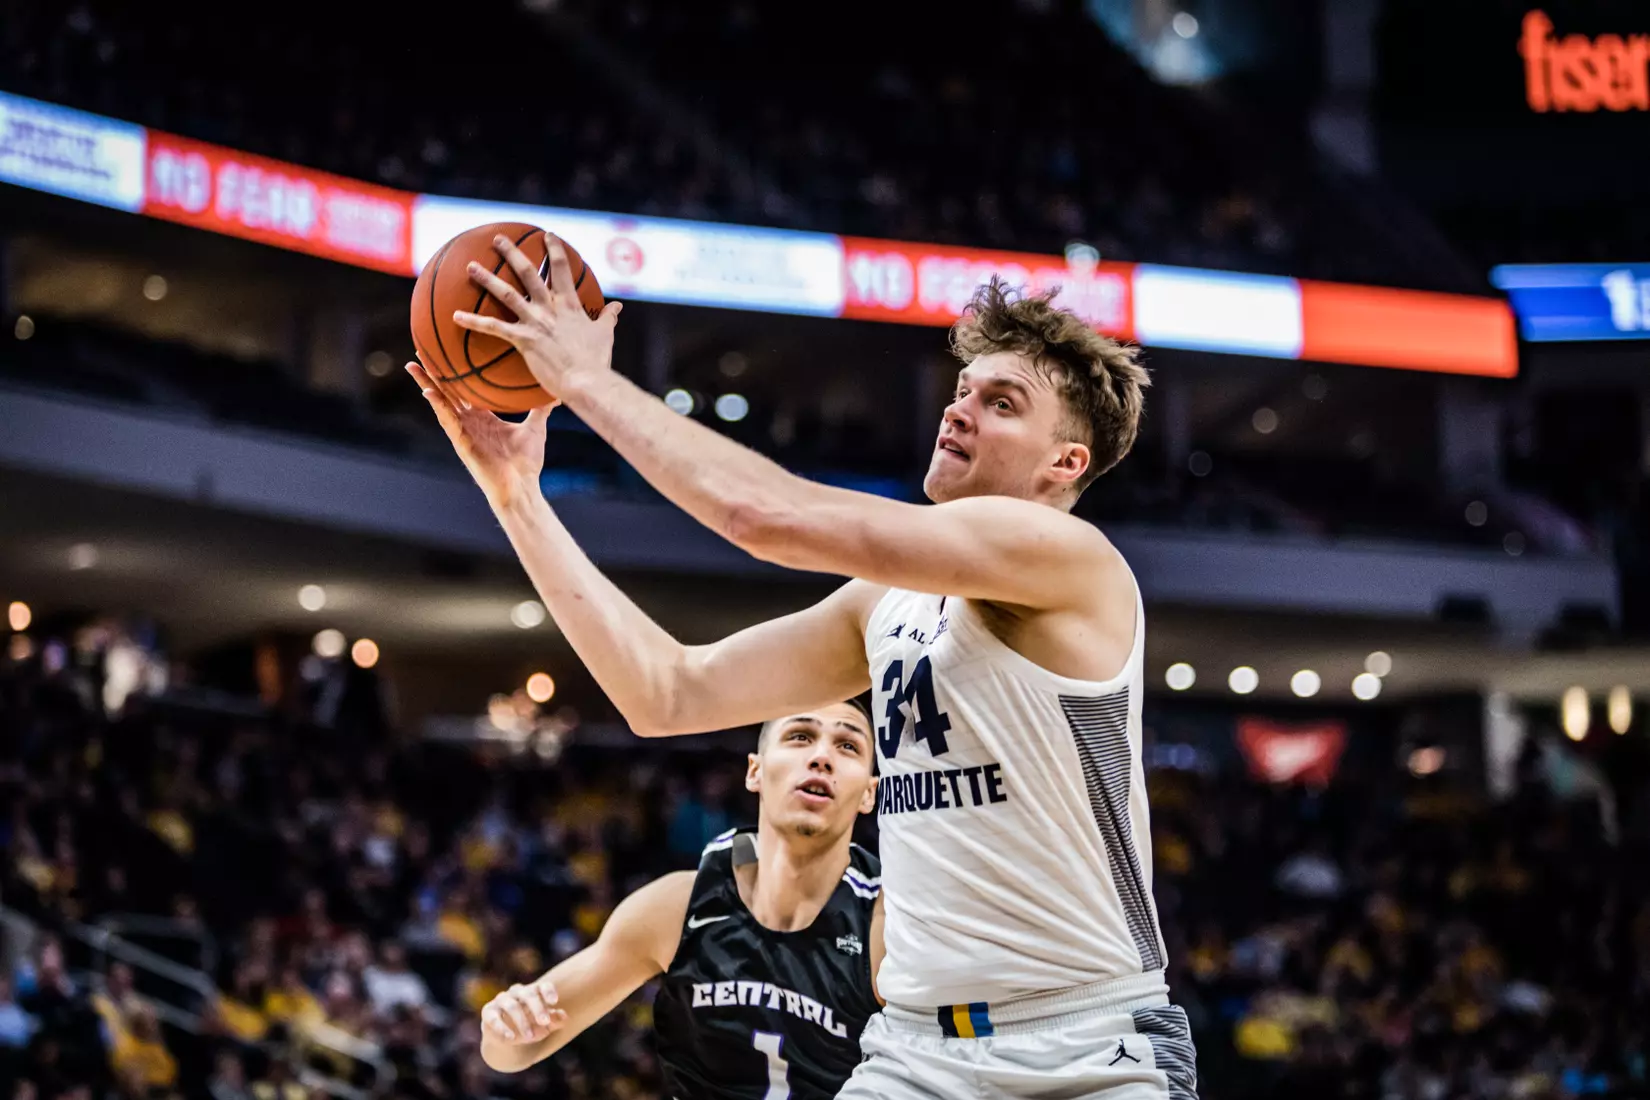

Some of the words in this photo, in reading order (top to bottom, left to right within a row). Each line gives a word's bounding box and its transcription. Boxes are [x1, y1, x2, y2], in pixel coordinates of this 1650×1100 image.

[907, 628, 926, 645] AL
[878, 655, 952, 759] 34
[691, 980, 848, 1038] CENTRAL
[752, 1029, 791, 1100] 1
